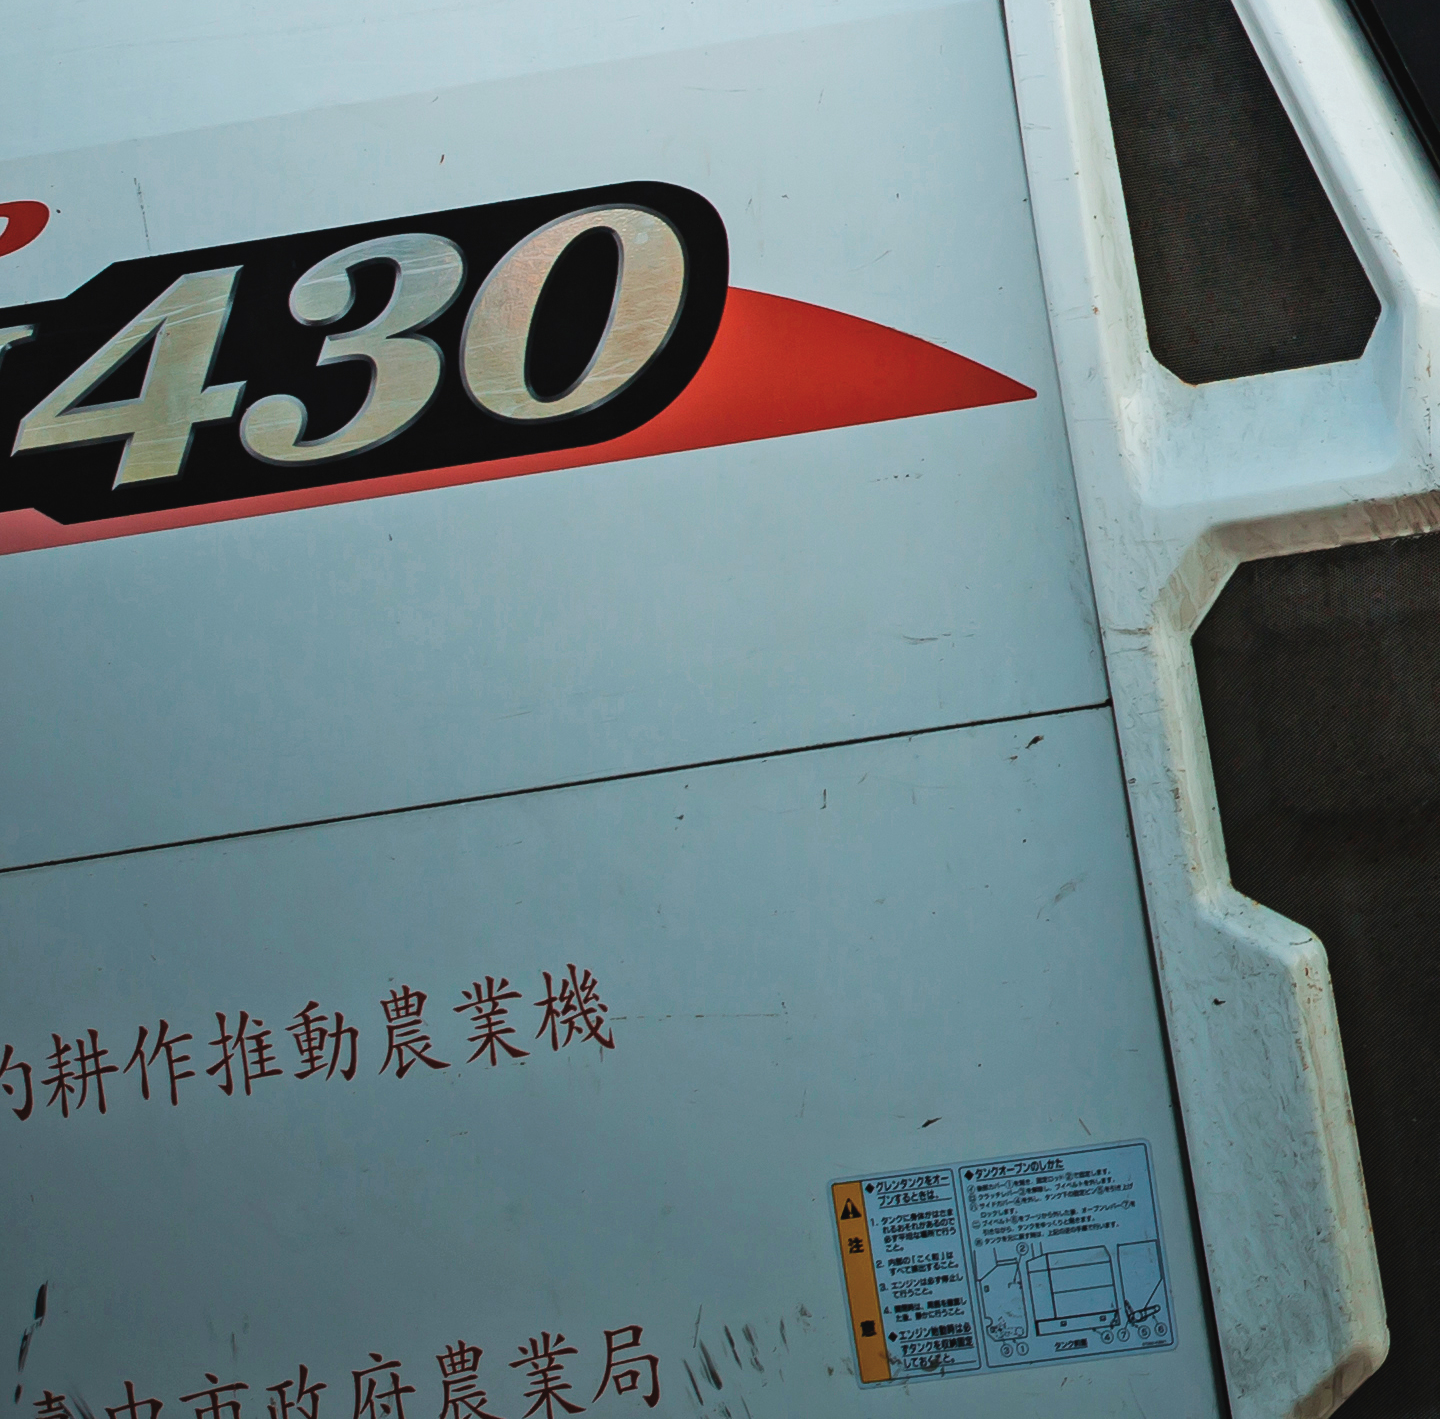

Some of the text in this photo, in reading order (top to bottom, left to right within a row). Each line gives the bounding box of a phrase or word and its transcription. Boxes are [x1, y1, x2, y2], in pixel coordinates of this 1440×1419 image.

[0, 203, 688, 492] 430
[974, 1156, 1064, 1181] タンクオープンのしかた
[1054, 1338, 1088, 1351] タンク
